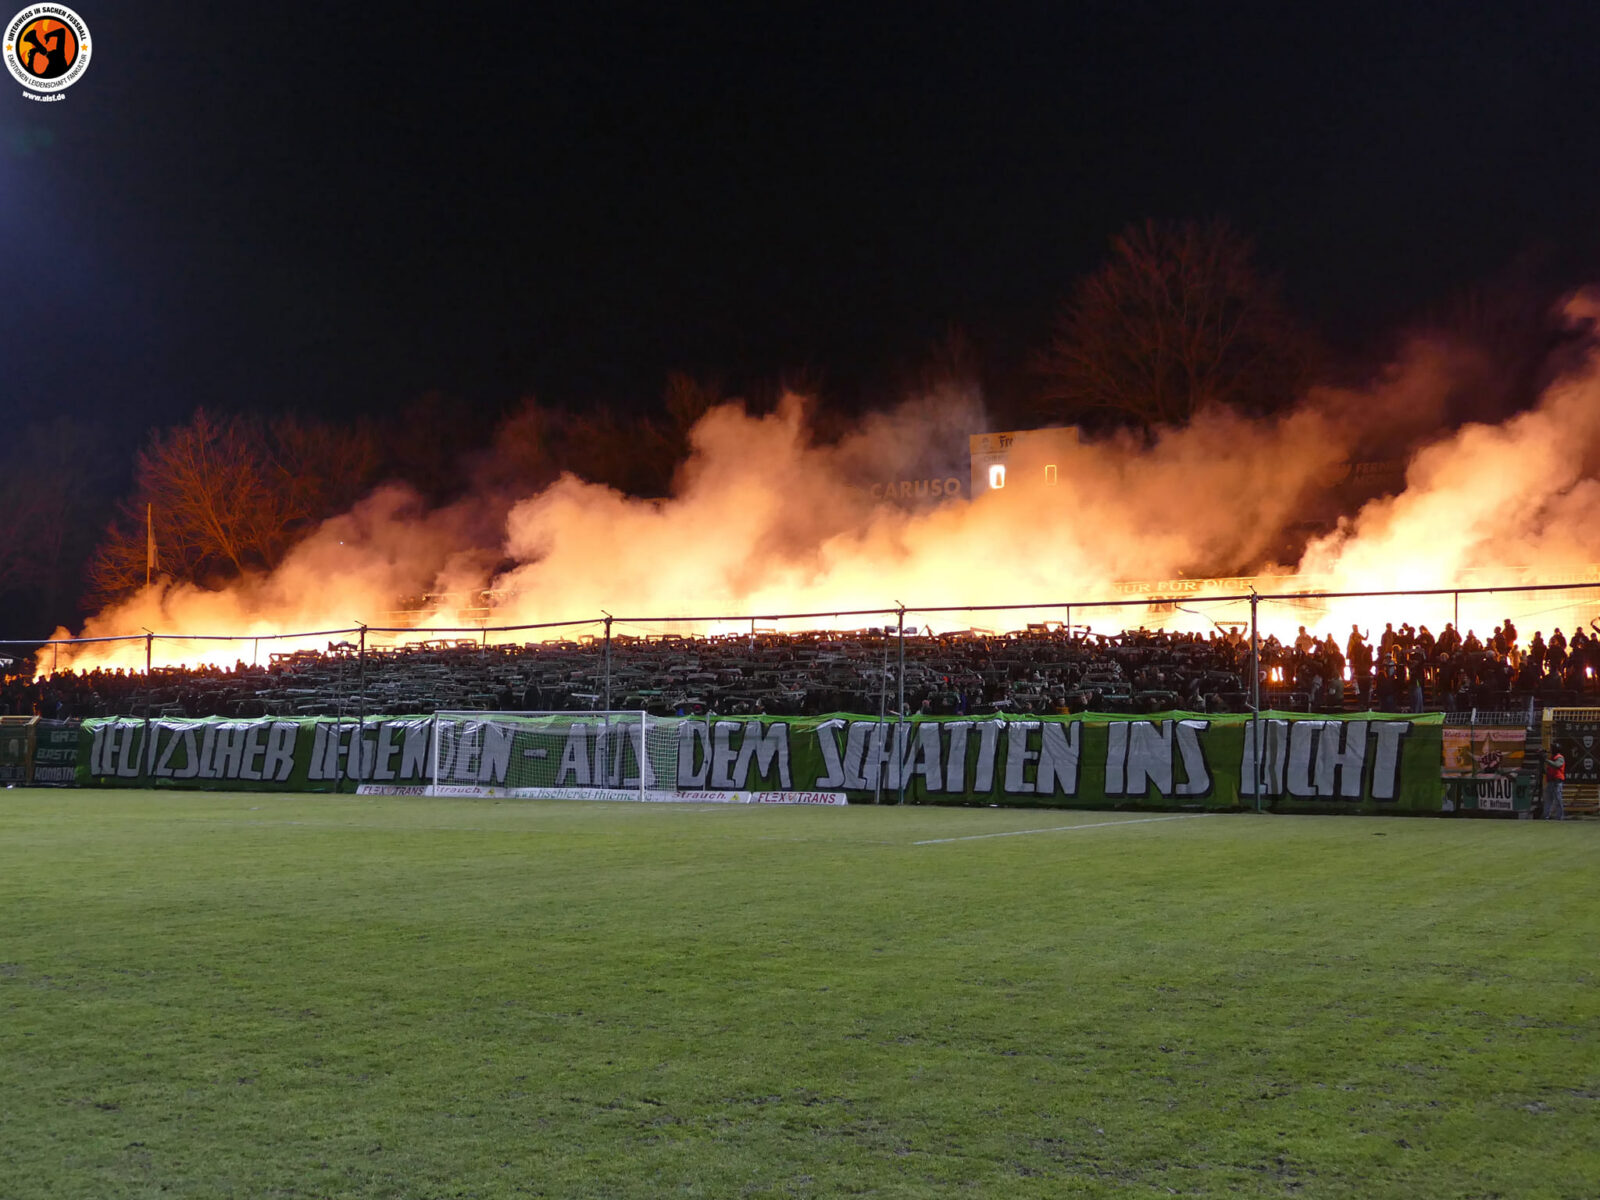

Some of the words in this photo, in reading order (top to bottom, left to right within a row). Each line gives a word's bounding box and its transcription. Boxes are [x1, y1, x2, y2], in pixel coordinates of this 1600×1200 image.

[870, 477, 961, 499] CARUSO
[90, 719, 300, 782] LEUTZSCHER
[308, 719, 518, 784] LEGENDEN
[555, 721, 658, 790] AUS
[676, 719, 792, 791] DEM
[815, 718, 1080, 796] SCHATTEN
[1104, 718, 1215, 799] INS
[1239, 718, 1414, 803] LICHT
[393, 785, 425, 797] TRANS
[757, 792, 787, 803] FLEX
[797, 792, 837, 804] TRANS
